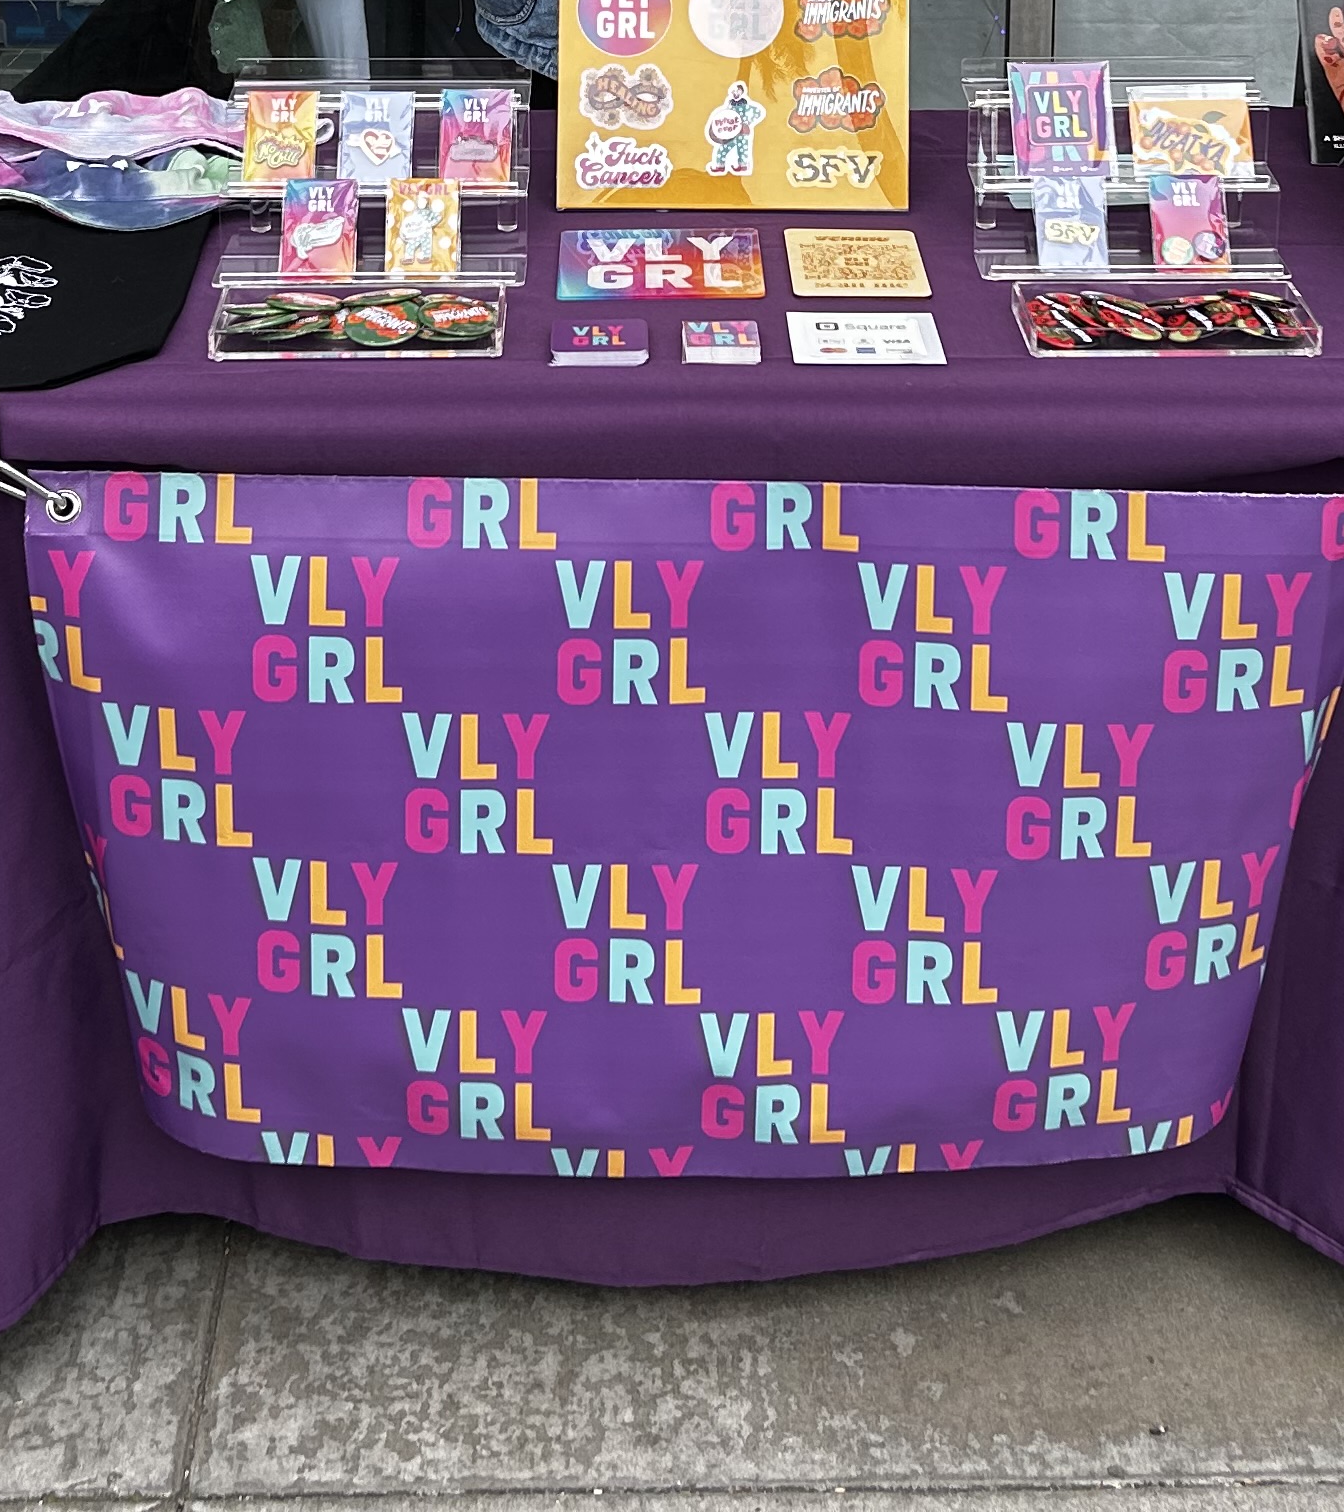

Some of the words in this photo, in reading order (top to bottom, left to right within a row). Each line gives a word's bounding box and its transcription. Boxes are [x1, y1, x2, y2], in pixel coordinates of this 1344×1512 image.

[596, 11, 655, 39] GRL
[271, 110, 297, 123] GRL
[272, 98, 297, 111] VLY
[365, 110, 390, 123] GRL
[366, 99, 390, 111] VLY
[463, 110, 490, 123] GRL
[464, 98, 489, 110] VLY
[596, 78, 659, 117] HEALING
[798, 90, 879, 116] IMMIGRANTS
[1032, 90, 1082, 114] VLY
[1035, 115, 1088, 138] GRL
[579, 157, 665, 186] Cancer
[605, 141, 663, 167] Fuck
[794, 152, 878, 184] SFV
[308, 199, 335, 212] GRL
[309, 187, 335, 200] VLY
[1171, 183, 1197, 195] VLY
[1172, 194, 1200, 207] GRL
[587, 236, 735, 263] VLY
[1049, 222, 1096, 241] SFV
[587, 263, 743, 289] GRL
[572, 326, 625, 336] VLY
[572, 335, 626, 346] GRL
[687, 322, 755, 333] VLY
[687, 333, 757, 346] GRL
[844, 322, 908, 332] Square
[105, 471, 253, 544] GRL
[409, 477, 557, 550] GRL
[711, 481, 859, 551] GRL
[1015, 490, 1165, 562] GRL
[252, 555, 397, 627] VLY
[557, 560, 704, 629] VLY
[859, 562, 1006, 633] VLY
[1164, 572, 1311, 640] VLY
[253, 635, 403, 704] GRL
[558, 638, 706, 705] GRL
[859, 640, 1008, 712] GRL
[1163, 645, 1304, 714] GRL
[102, 702, 246, 775] VLY
[403, 712, 549, 780] VLY
[705, 711, 851, 779] VLY
[1007, 722, 1154, 788] VLY
[110, 774, 253, 847] GRL
[405, 787, 554, 855] GRL
[706, 787, 853, 855] GRL
[1006, 795, 1152, 860] GRL
[253, 857, 398, 926] VLY
[552, 864, 699, 931] VLY
[852, 865, 998, 934] VLY
[1150, 845, 1280, 924] VLY
[257, 930, 404, 999] GRL
[554, 938, 701, 1005] GRL
[852, 940, 998, 1005] GRL
[1145, 913, 1265, 990] GRL
[126, 971, 252, 1057] VLY
[403, 1007, 547, 1075] VLY
[700, 1010, 844, 1078] VLY
[997, 1002, 1136, 1072] VLY
[138, 1036, 261, 1124] GRL
[406, 1079, 552, 1142] GRL
[993, 1068, 1131, 1133] GRL
[701, 1082, 845, 1145] GRL
